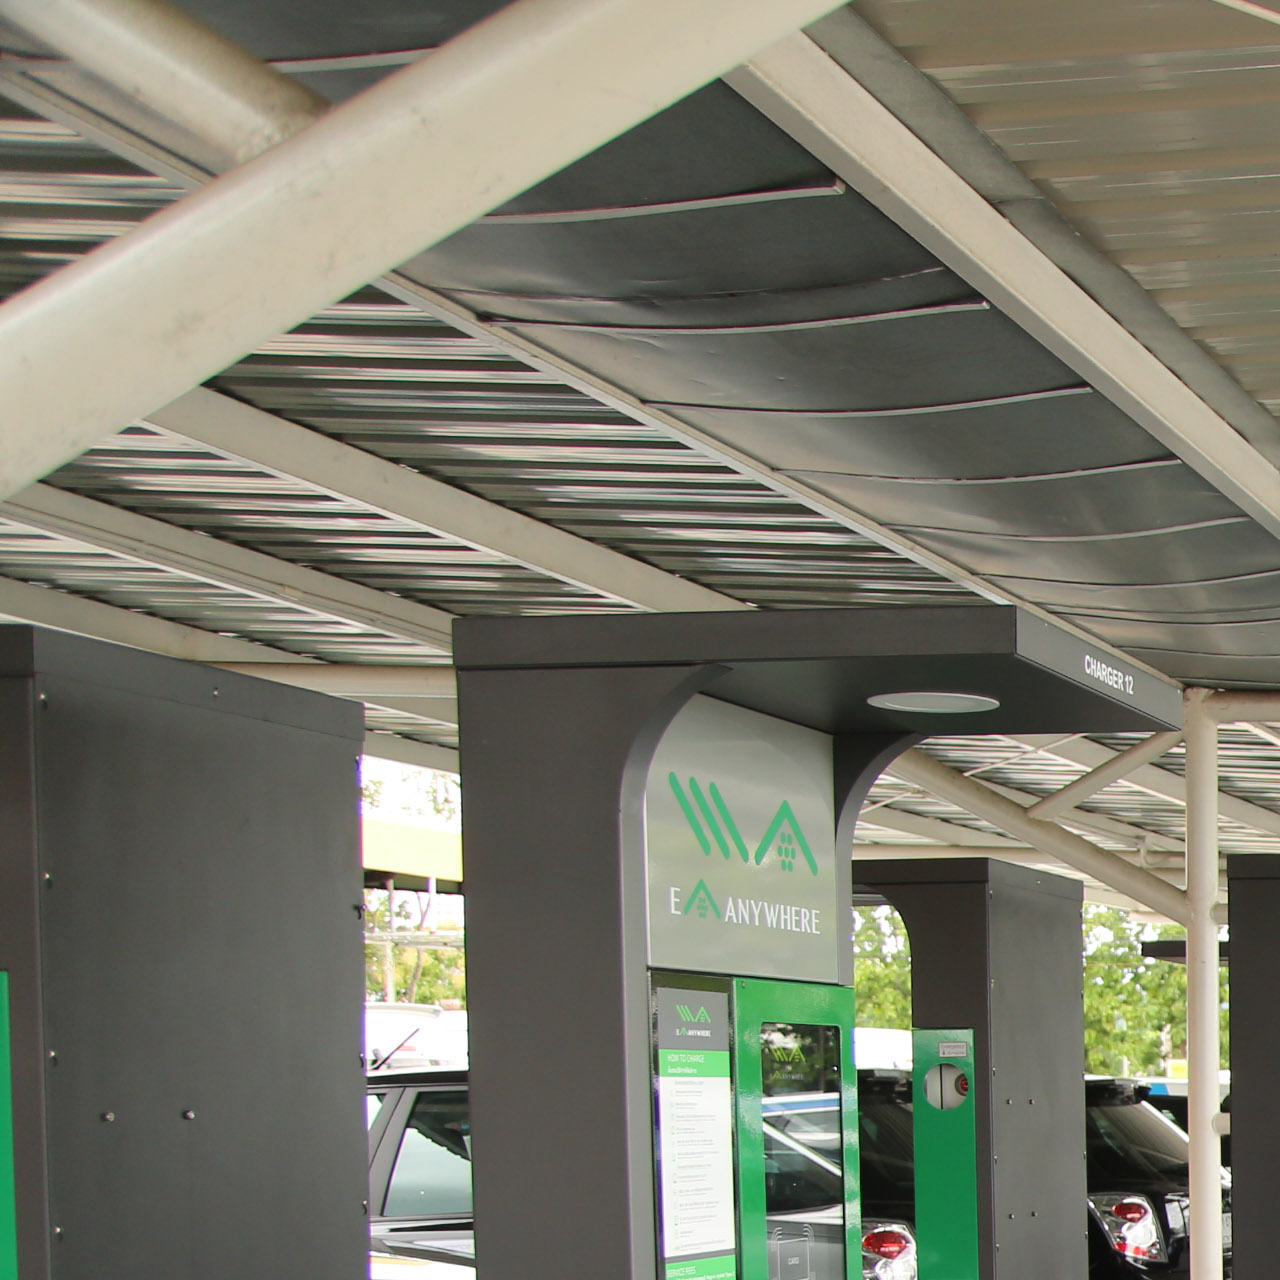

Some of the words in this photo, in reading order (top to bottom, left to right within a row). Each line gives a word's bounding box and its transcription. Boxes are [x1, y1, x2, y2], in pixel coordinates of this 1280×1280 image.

[1084, 654, 1124, 692] CHARGER
[1125, 674, 1134, 696] 12
[724, 896, 821, 934] ANYWHERE
